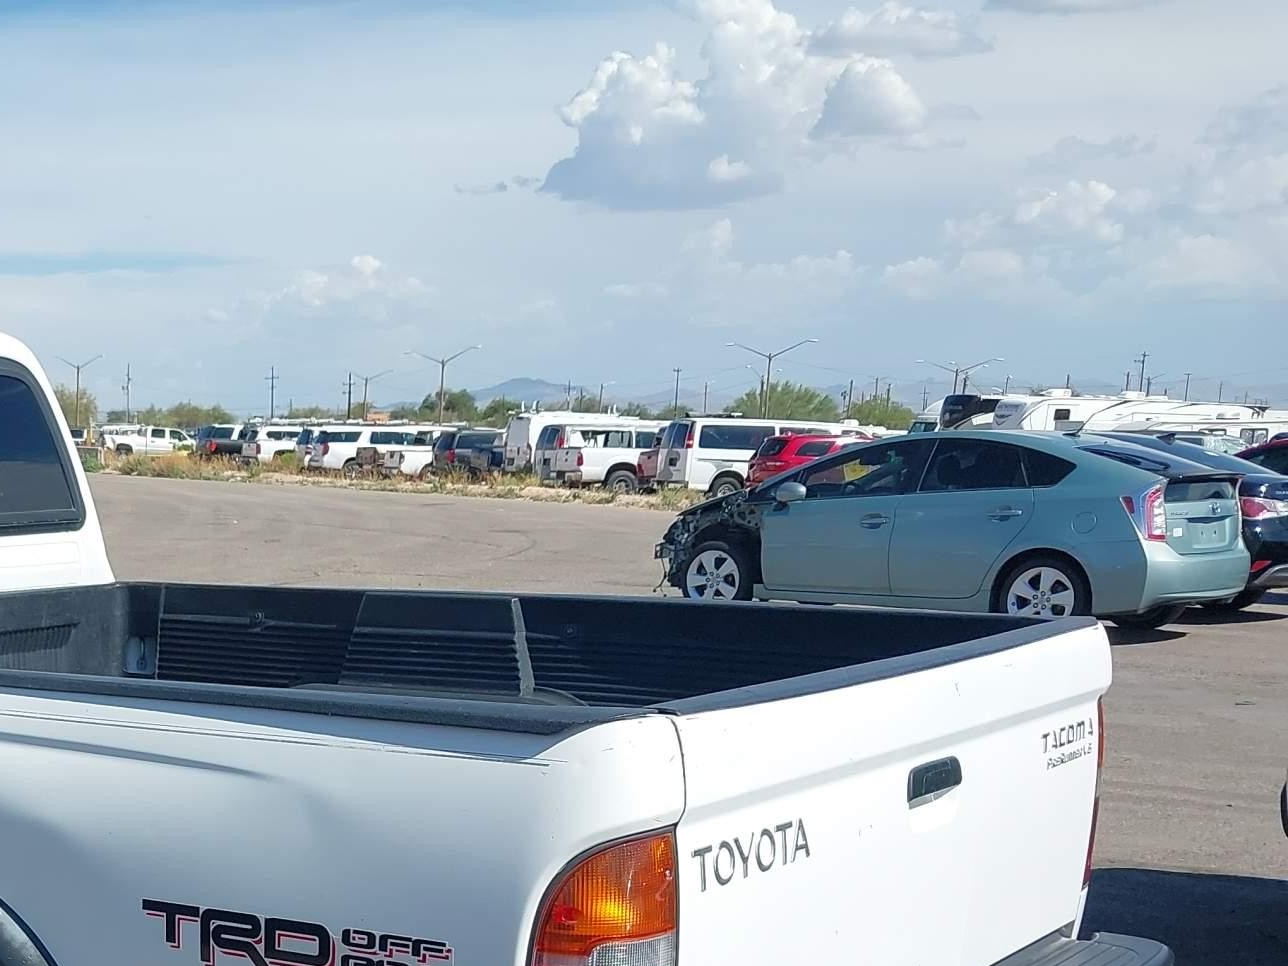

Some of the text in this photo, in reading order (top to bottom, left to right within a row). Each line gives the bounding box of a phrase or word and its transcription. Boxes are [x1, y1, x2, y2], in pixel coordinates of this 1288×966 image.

[1041, 718, 1093, 753] TACOMA
[691, 818, 811, 893] TOYOTA
[340, 928, 454, 963] OFF
